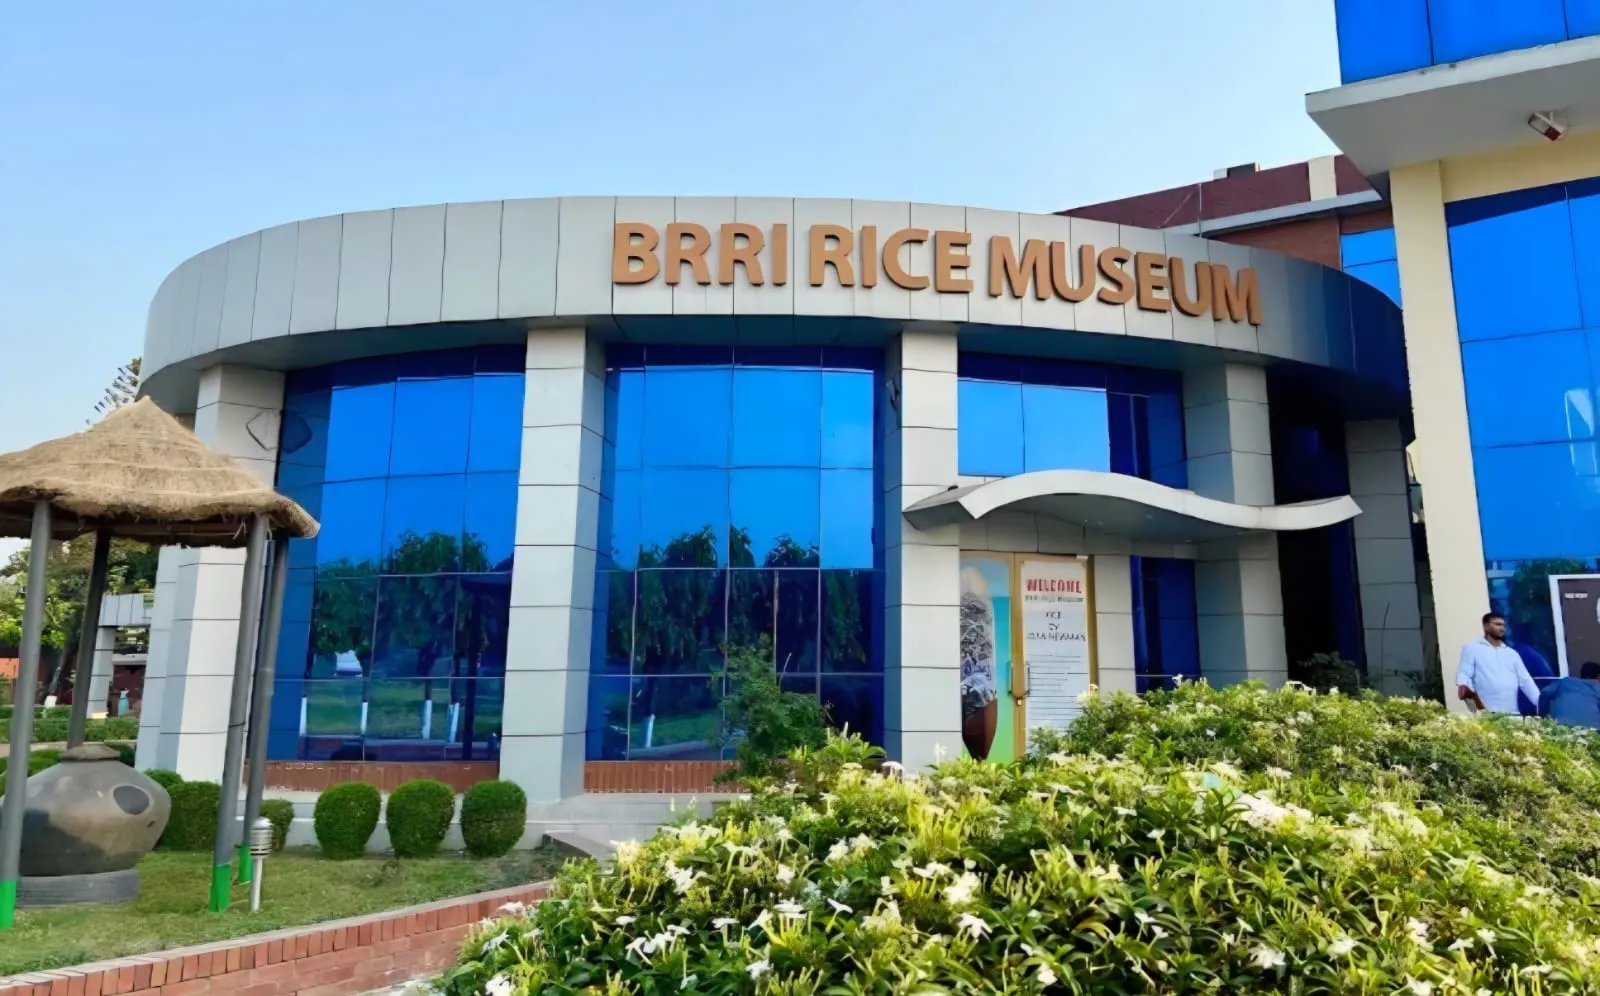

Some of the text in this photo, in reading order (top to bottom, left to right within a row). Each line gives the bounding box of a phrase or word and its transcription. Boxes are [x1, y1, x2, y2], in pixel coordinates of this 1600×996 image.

[612, 223, 1263, 326] BRRI RICE MUSEUM
